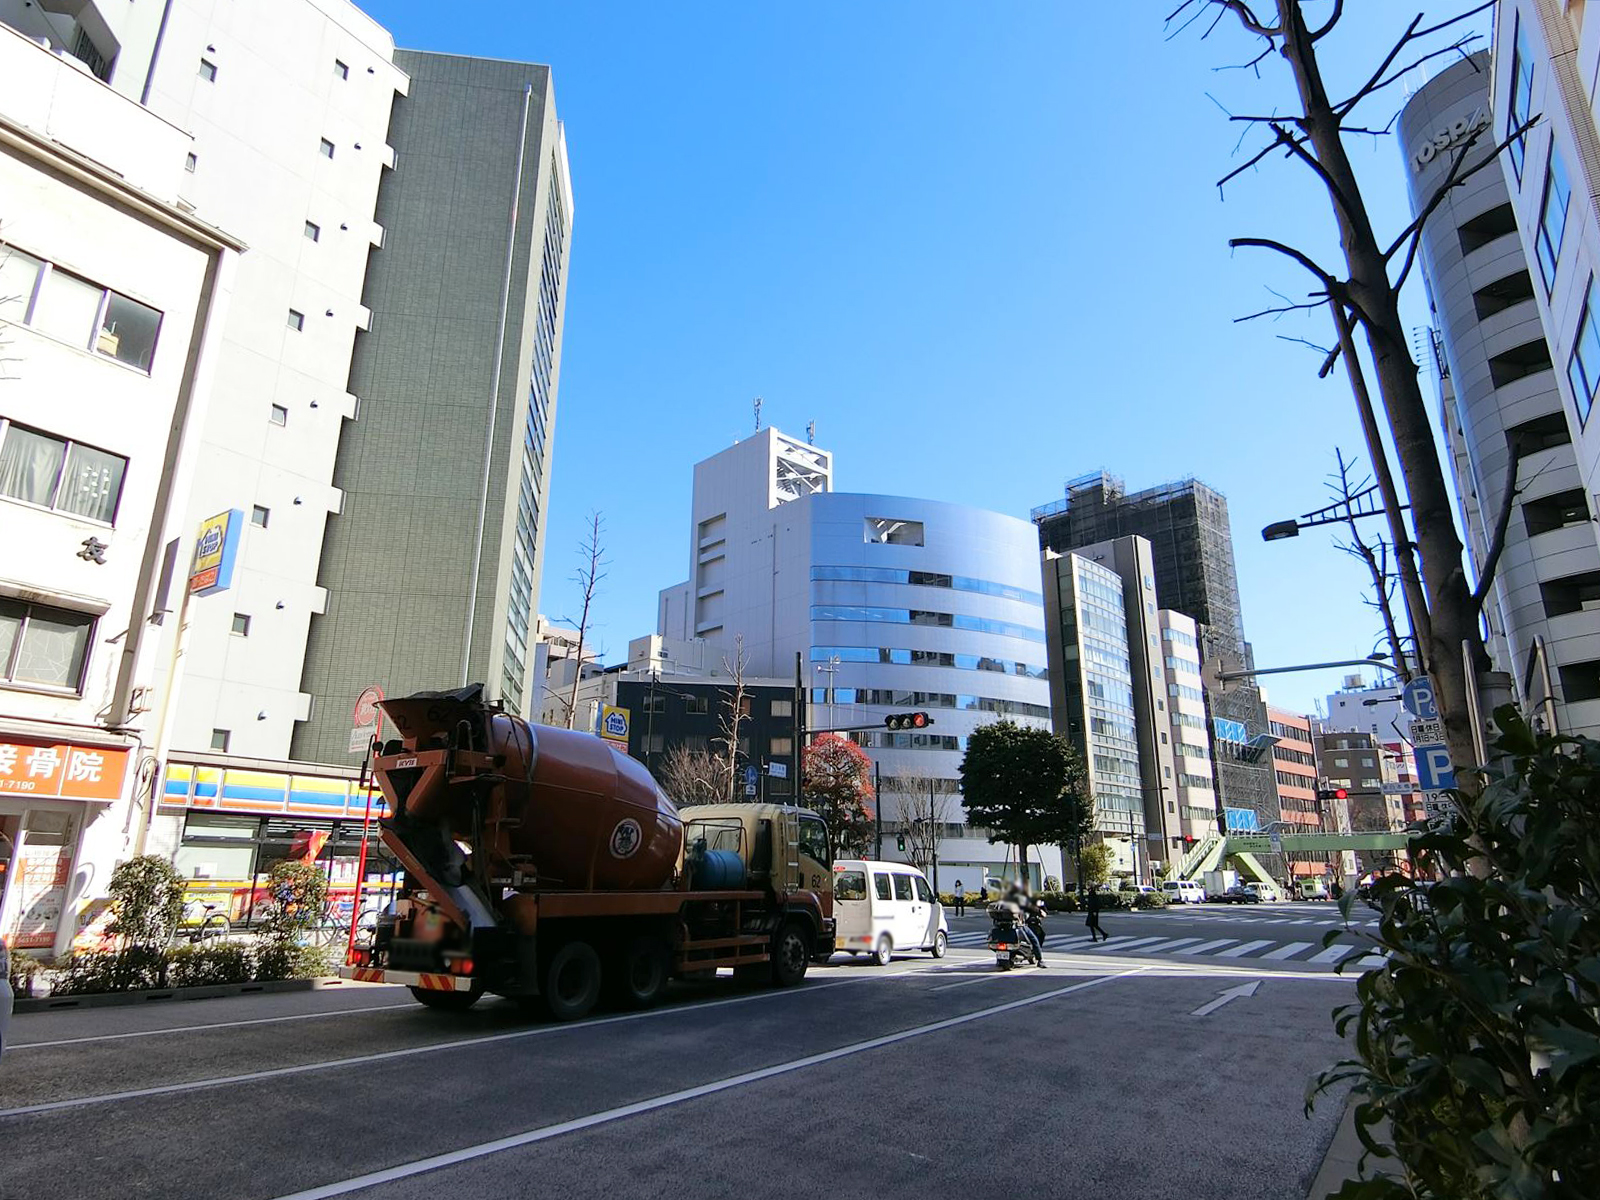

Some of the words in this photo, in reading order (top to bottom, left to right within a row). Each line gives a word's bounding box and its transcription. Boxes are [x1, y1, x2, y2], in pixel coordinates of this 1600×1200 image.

[202, 541, 218, 554] STOP
[1412, 688, 1432, 716] P
[609, 723, 625, 732] STOP
[610, 717, 624, 726] MINI
[1426, 749, 1453, 786] P
[811, 874, 821, 888] 62
